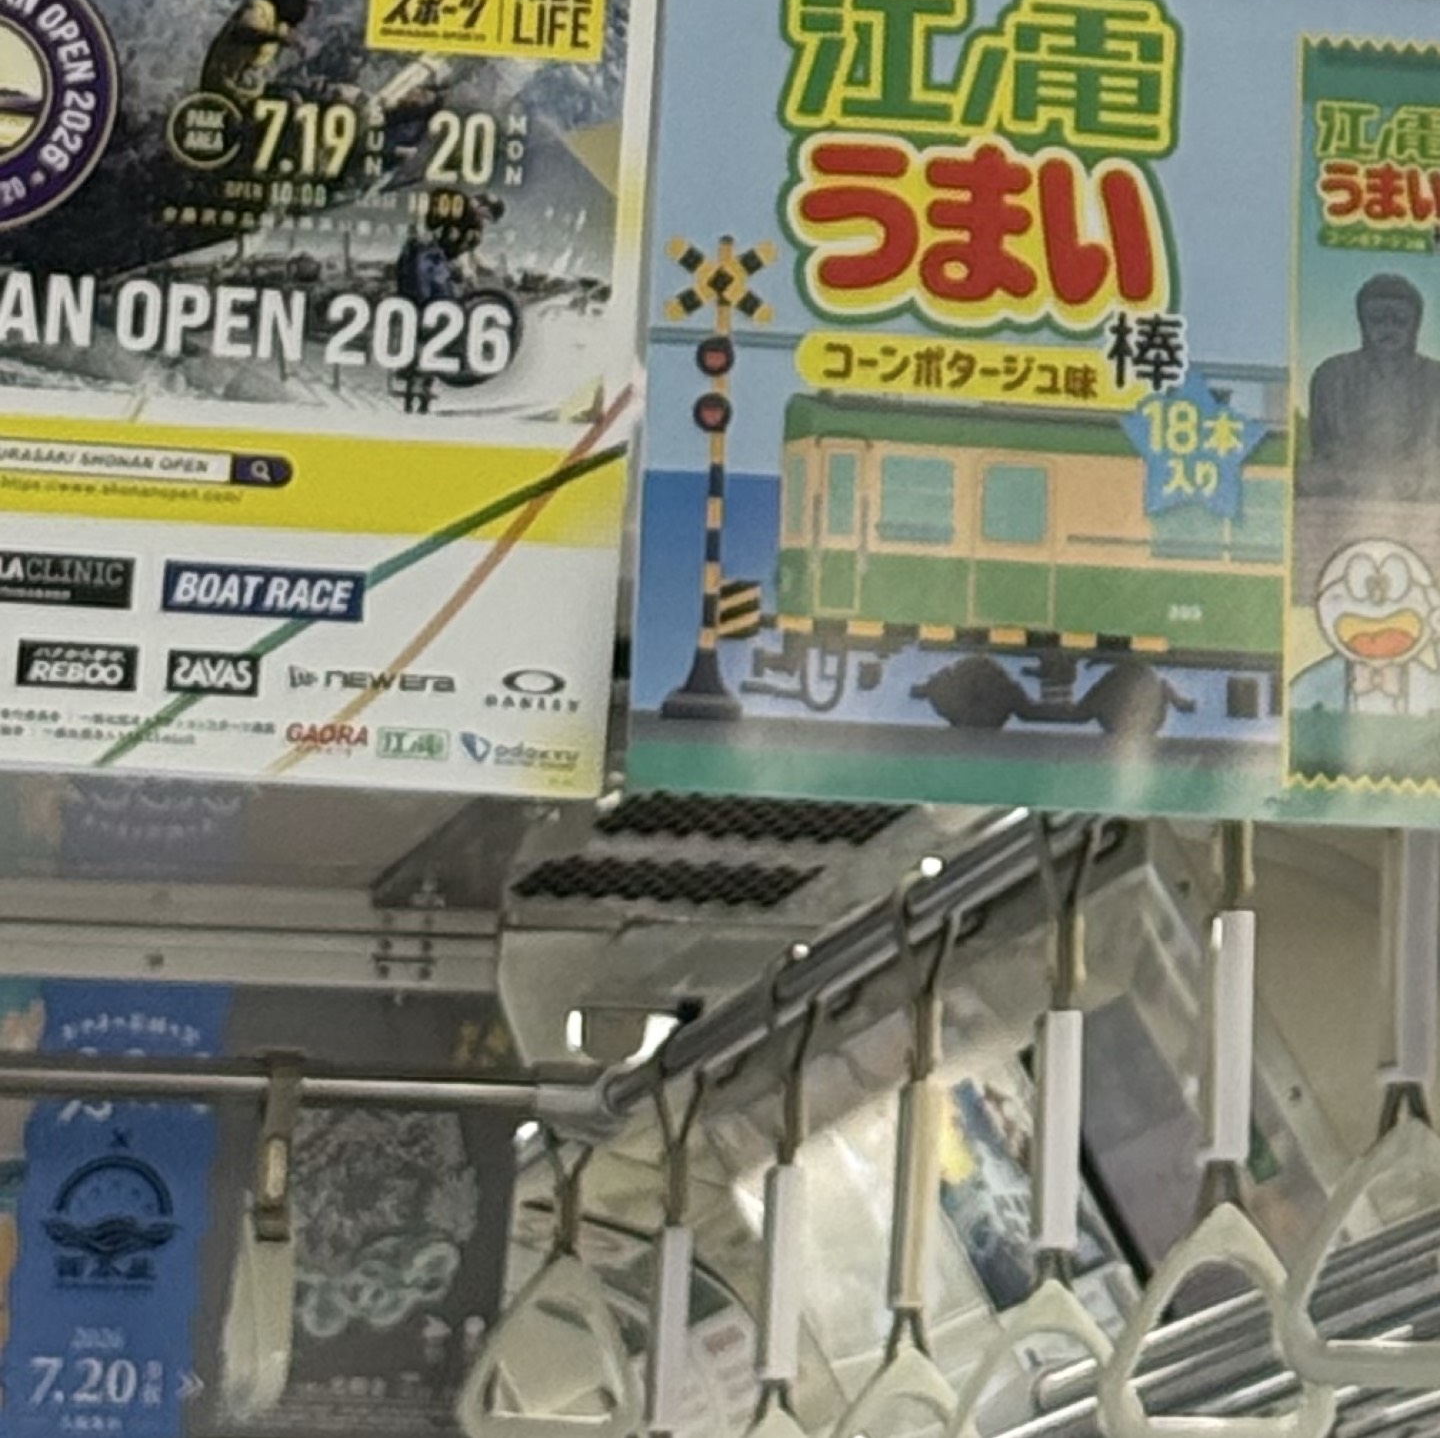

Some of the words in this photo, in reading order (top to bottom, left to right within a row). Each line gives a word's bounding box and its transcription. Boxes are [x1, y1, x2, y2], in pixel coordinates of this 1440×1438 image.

[37, 4, 97, 82] OPEN
[512, 2, 592, 48] LIFE
[40, 90, 96, 172] 2026
[253, 100, 358, 176] 7.19
[426, 110, 496, 184] 20
[802, 144, 1154, 305] うまい
[0, 270, 93, 348] AN
[115, 278, 302, 362] OPEN
[323, 296, 515, 376] 2026
[1107, 314, 1183, 391] 棒
[823, 341, 1098, 401] コーンポタージュ味
[1142, 402, 1244, 456] 18本
[1163, 459, 1218, 497] 入り
[173, 571, 262, 606] BOAT
[263, 574, 354, 613] RACE
[28, 1357, 137, 1406] 7.20
